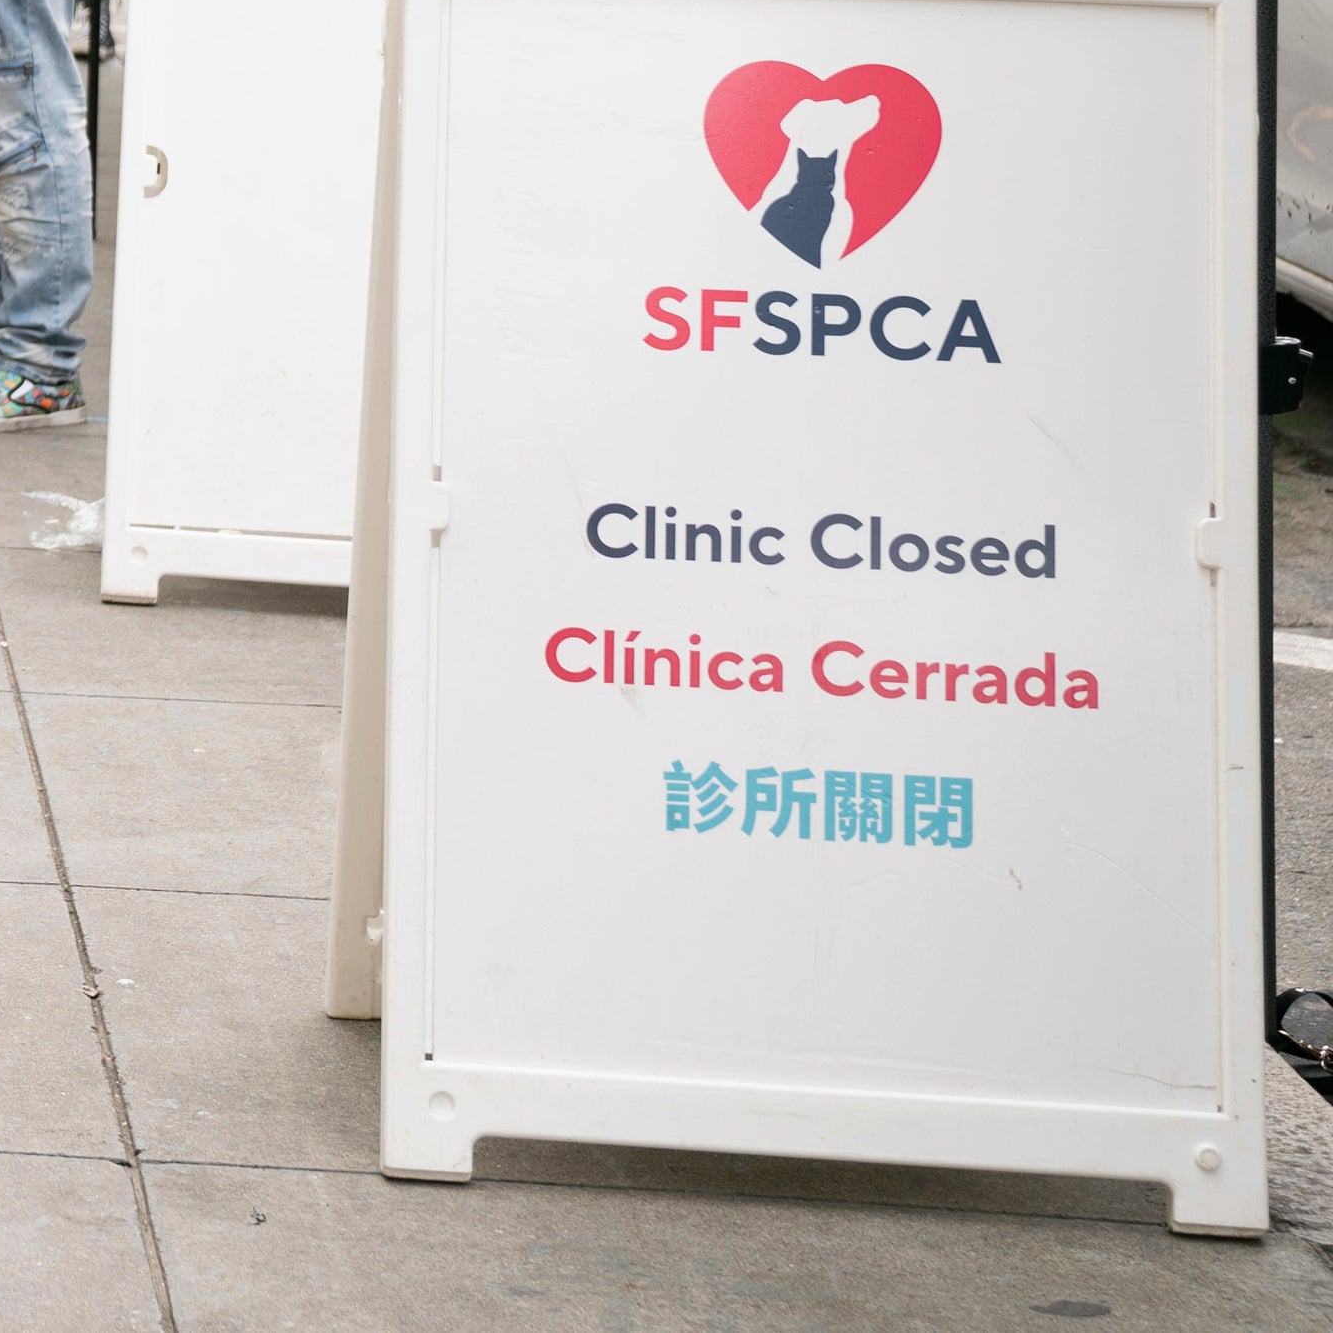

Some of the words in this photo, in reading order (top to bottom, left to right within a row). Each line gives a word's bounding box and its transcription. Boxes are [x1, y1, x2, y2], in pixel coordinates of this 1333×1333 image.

[642, 286, 1002, 364] SFSPCA
[586, 503, 786, 565] Clinic
[810, 513, 1057, 579] Closed
[544, 626, 785, 693] Clínica
[810, 640, 1101, 710] Cerrada
[664, 760, 974, 849] 診所關閉
